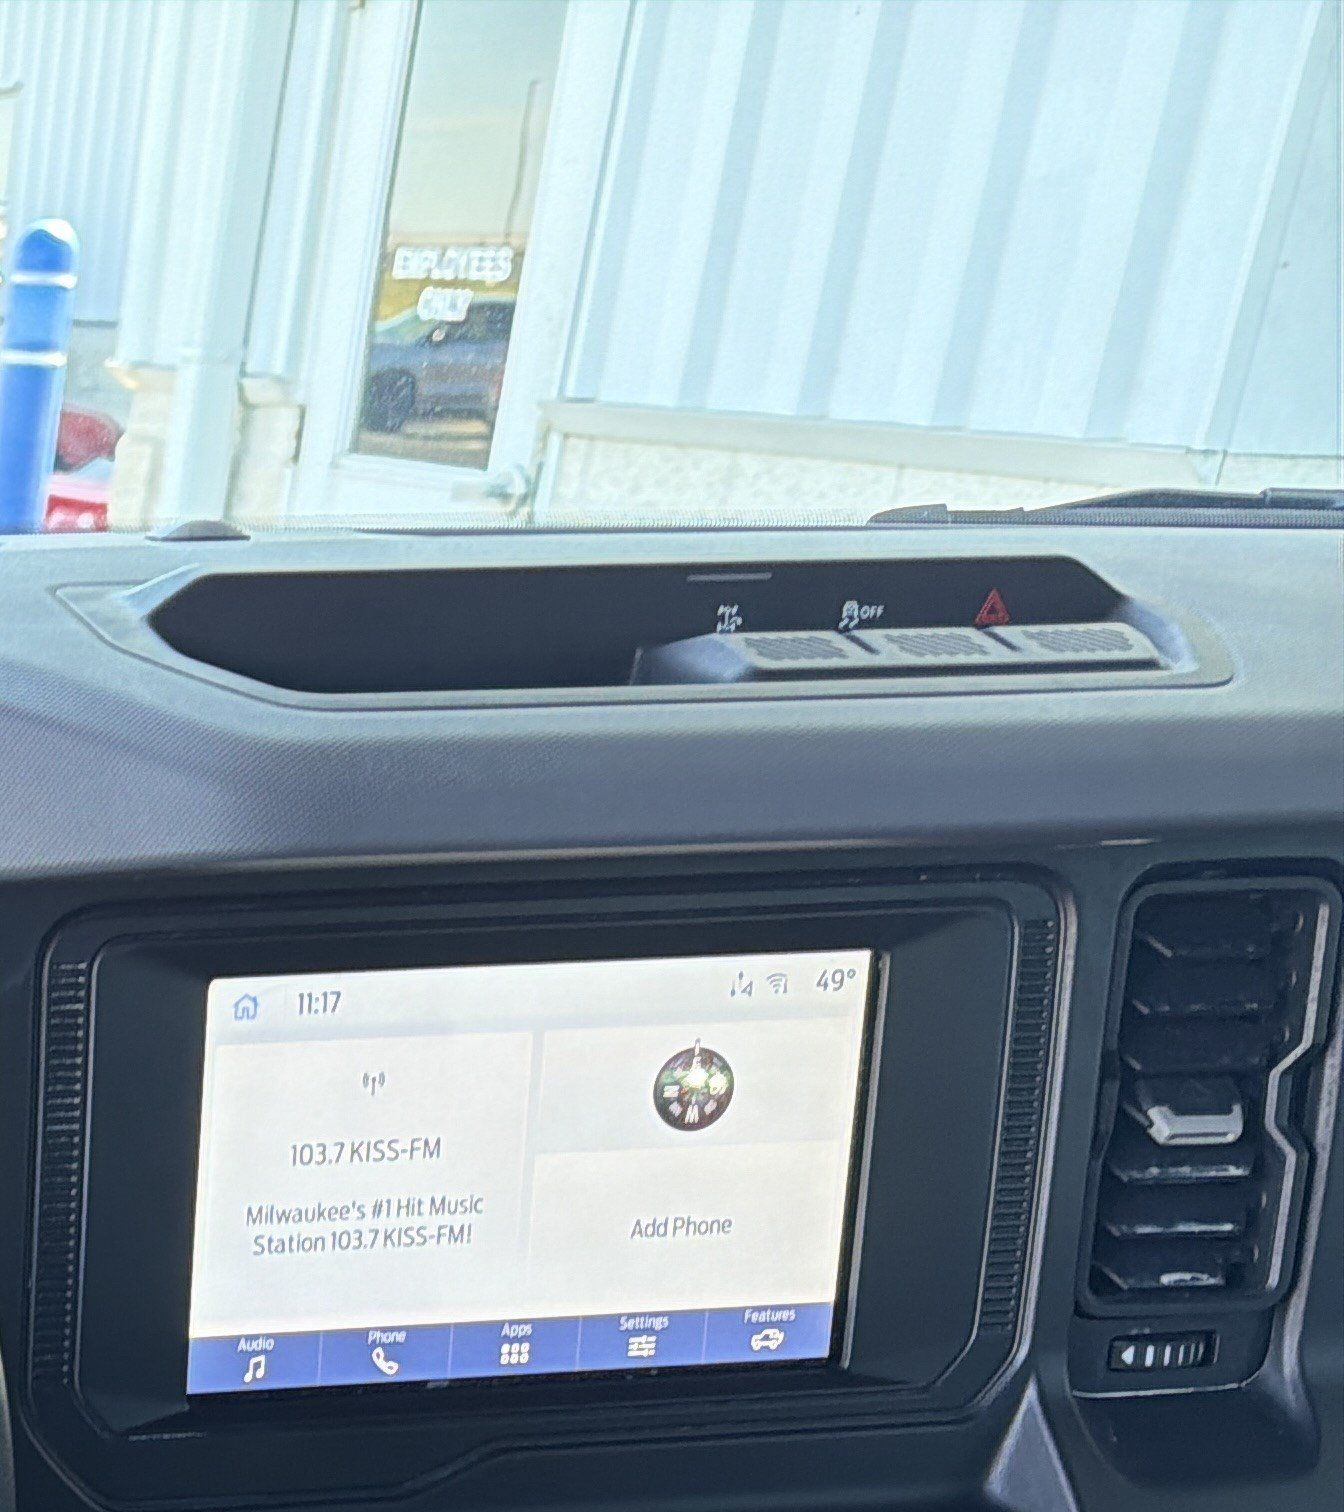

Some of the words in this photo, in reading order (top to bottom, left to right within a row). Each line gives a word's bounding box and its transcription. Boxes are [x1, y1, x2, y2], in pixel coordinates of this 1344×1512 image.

[860, 605, 885, 620] OFF
[816, 968, 857, 992] 49°
[298, 990, 342, 1016] 11:17
[290, 1140, 345, 1167] 103.7
[349, 1137, 442, 1164] KISS-FM
[246, 1201, 366, 1228] Milwaukee's
[372, 1198, 393, 1219] #1
[395, 1197, 424, 1219] Hit
[429, 1195, 484, 1217] Music
[631, 1217, 668, 1239] Add
[672, 1215, 733, 1238] Phone
[252, 1231, 326, 1257] Station
[330, 1227, 379, 1253] 103.7
[382, 1223, 473, 1247] KISS-FM!
[619, 1315, 669, 1331] Settings
[744, 1308, 796, 1324] Features
[367, 1330, 407, 1346] Phone
[500, 1322, 533, 1339] Apps
[237, 1336, 275, 1352] Audio
